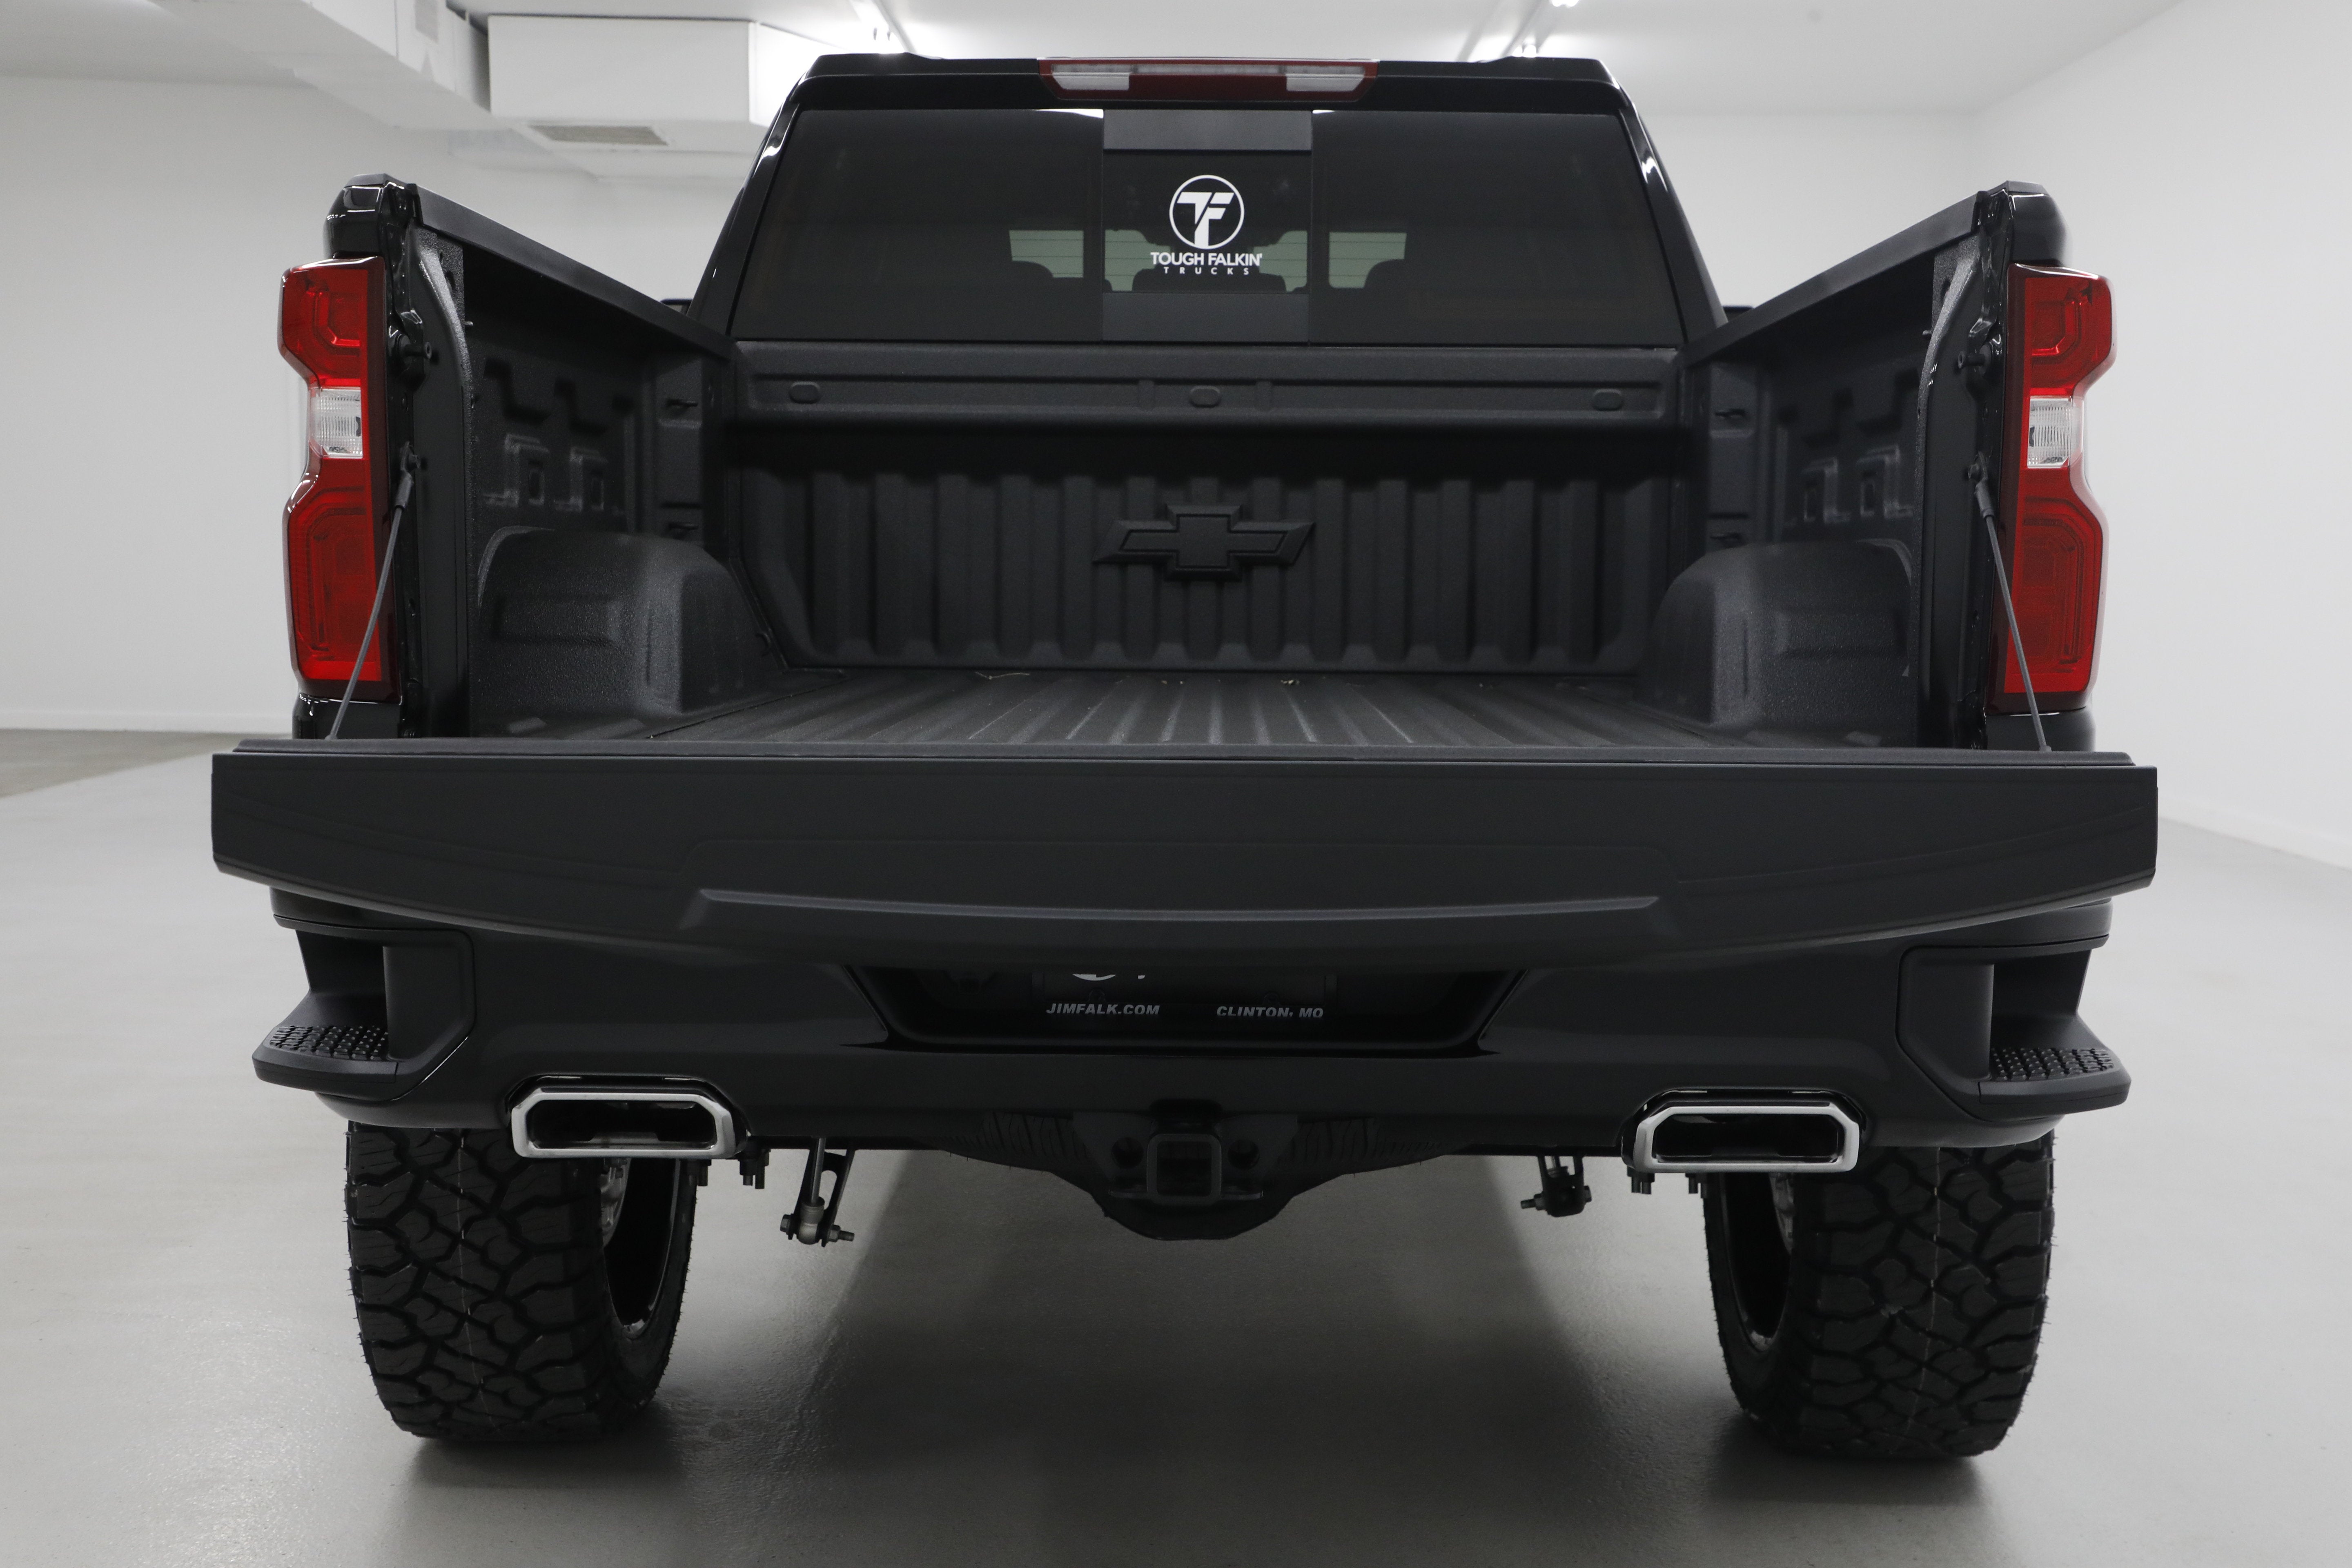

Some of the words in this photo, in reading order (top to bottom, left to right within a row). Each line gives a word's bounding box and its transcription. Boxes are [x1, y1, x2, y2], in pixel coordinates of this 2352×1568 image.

[1151, 252, 1204, 265] TOUGH
[1208, 252, 1263, 266] FALKIN'
[1164, 266, 1249, 275] TRUCKS
[1046, 1003, 1160, 1015] JIMFALK.COM
[1216, 1006, 1293, 1017] CLINTON,
[1299, 1007, 1324, 1018] MO
